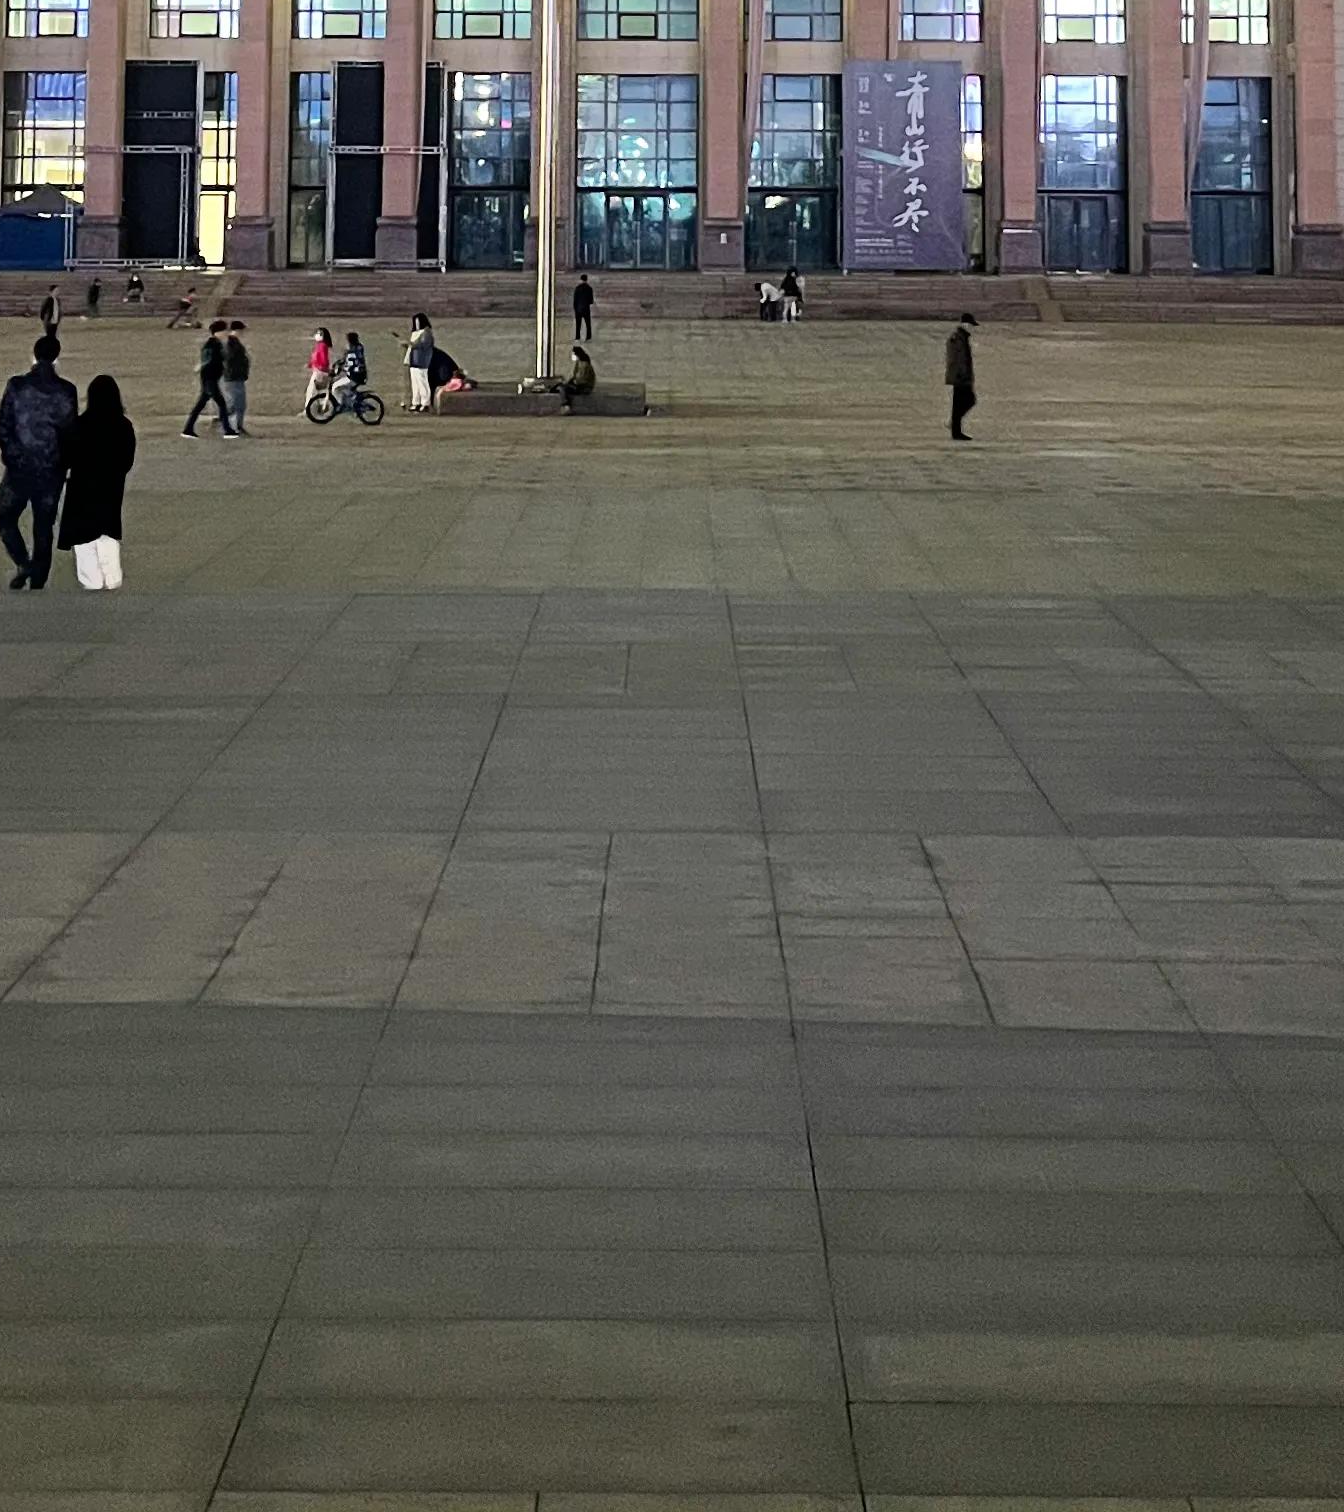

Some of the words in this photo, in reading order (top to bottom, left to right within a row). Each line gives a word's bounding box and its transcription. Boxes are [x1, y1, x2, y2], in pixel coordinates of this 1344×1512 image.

[893, 70, 930, 233] 青山行不尽
